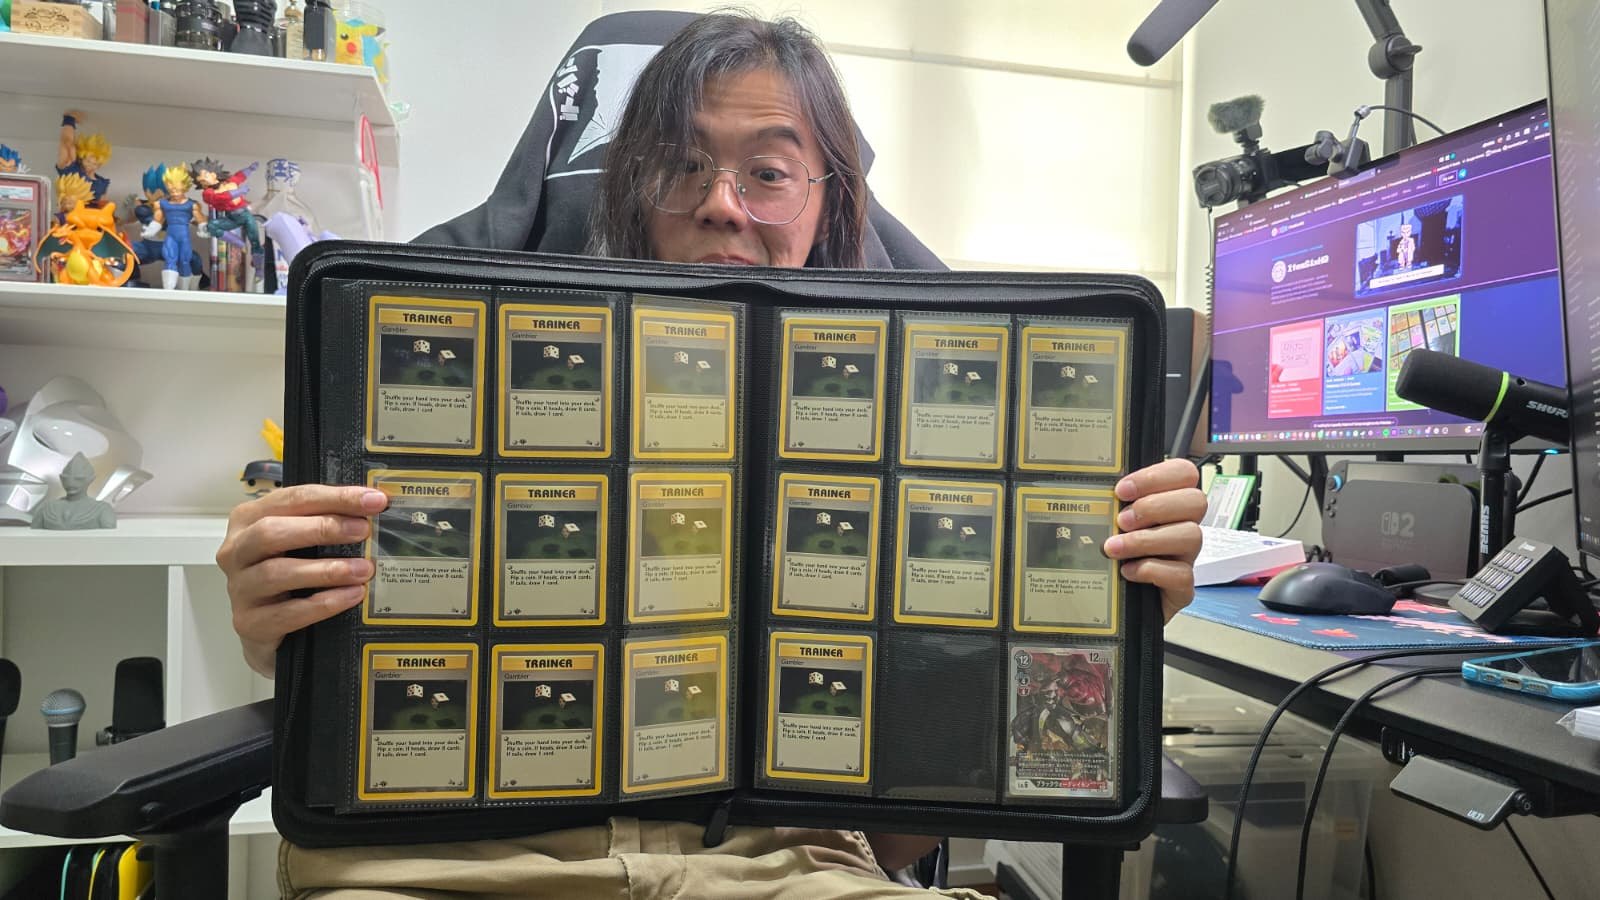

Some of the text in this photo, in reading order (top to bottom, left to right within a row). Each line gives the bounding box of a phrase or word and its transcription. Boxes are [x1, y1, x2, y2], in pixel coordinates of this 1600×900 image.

[402, 313, 452, 324] TRAINER
[381, 325, 408, 333] Gambler
[532, 319, 580, 330] TRAINER
[664, 325, 707, 337] TRAINER
[812, 332, 856, 342] TRAINER
[934, 338, 978, 348] TRAINER
[1051, 341, 1095, 352] TRAINER
[1526, 400, 1568, 418] SHUR
[400, 485, 449, 495] TRAINER
[527, 489, 576, 498] TRAINER
[660, 487, 704, 497] TRAINER
[807, 488, 851, 499] TRAINER
[928, 492, 973, 503] TRAINER
[1046, 502, 1090, 512] TRAINER
[1400, 513, 1415, 537] 2
[1480, 505, 1490, 554] SHURE
[799, 647, 843, 658] TRAINER
[396, 658, 446, 667] TRAINER
[524, 658, 572, 668] TRAINER
[654, 652, 698, 665] TRAINER
[780, 658, 804, 666] Gambler
[1019, 655, 1029, 665] 12
